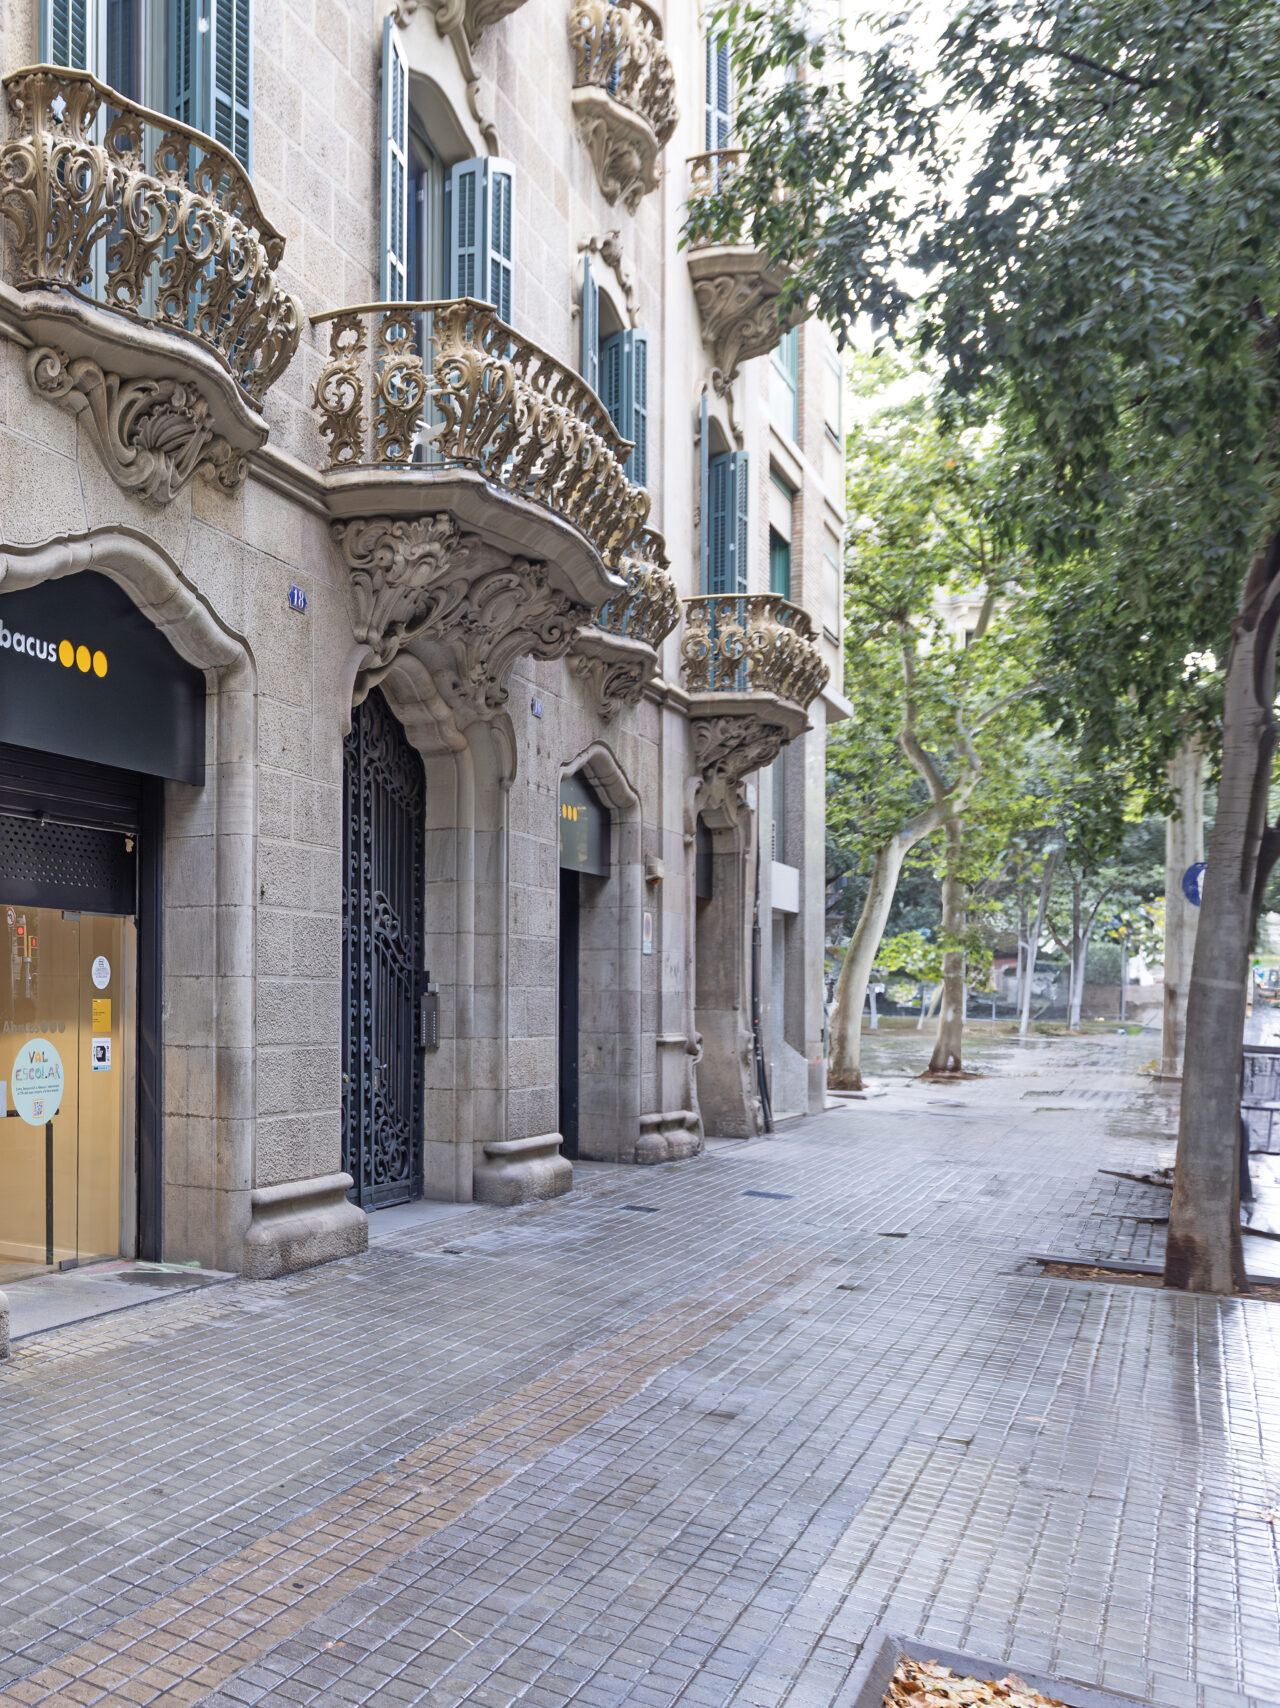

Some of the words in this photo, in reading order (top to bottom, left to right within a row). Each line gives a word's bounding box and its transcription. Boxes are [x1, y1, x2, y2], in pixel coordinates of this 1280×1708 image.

[293, 588, 305, 609] 18
[28, 1050, 49, 1065] VAL
[15, 1063, 61, 1081] ESCOLAR
